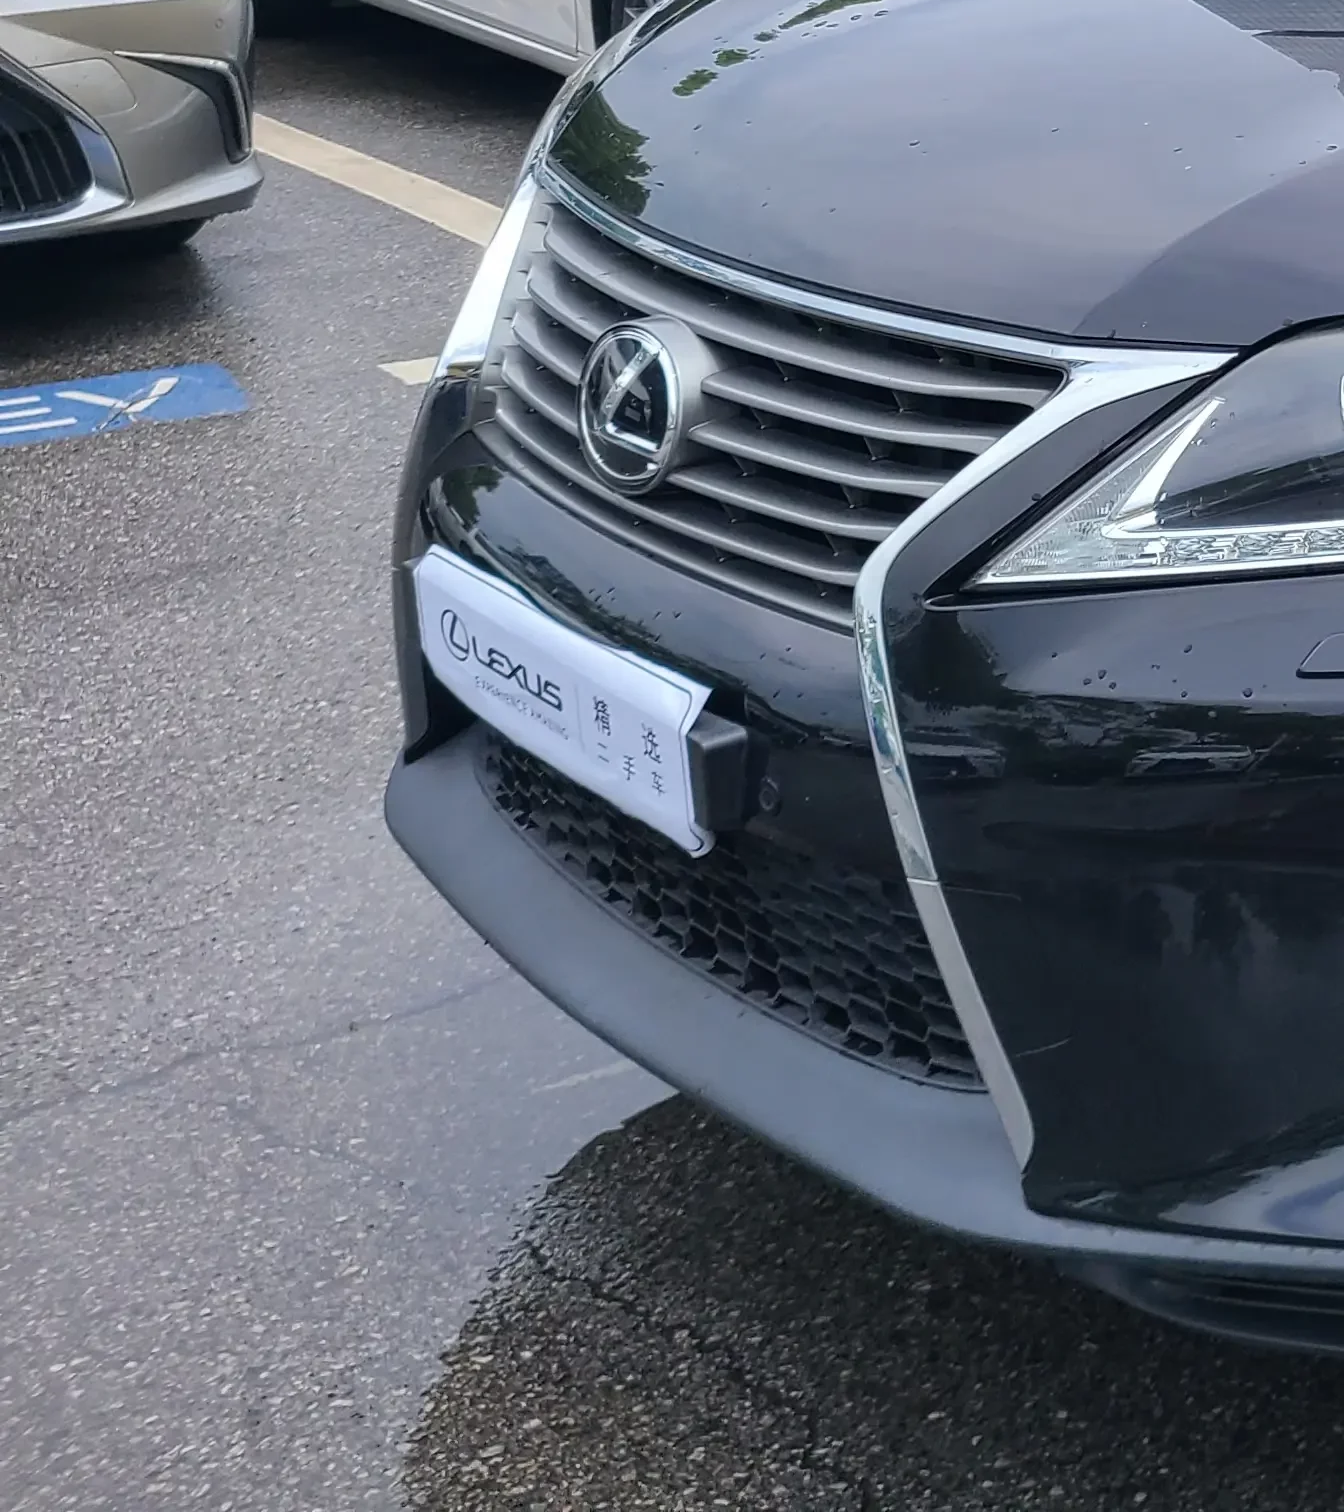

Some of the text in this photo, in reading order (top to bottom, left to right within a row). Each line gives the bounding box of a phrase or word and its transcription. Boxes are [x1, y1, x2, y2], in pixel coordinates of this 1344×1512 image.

[471, 635, 564, 712] LEXUS
[597, 742, 666, 797] 二手车
